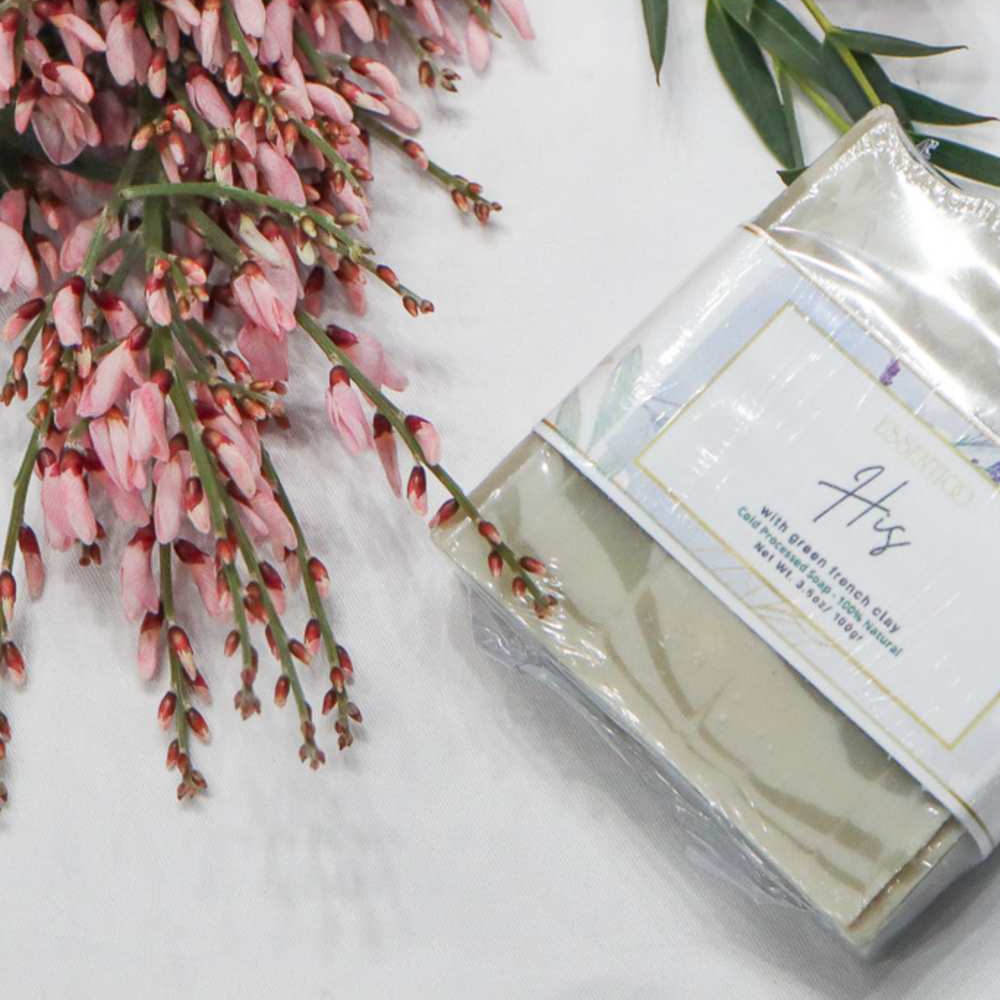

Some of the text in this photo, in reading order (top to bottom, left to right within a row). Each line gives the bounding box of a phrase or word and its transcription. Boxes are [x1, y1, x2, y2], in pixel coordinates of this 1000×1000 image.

[754, 541, 775, 562] Net
[813, 465, 911, 556] His
[737, 506, 761, 531] Cold
[761, 526, 808, 574] Processed
[806, 566, 831, 596] Soap
[838, 595, 862, 623] 100%
[863, 619, 903, 657] Natural
[761, 506, 902, 635] with green french clay
